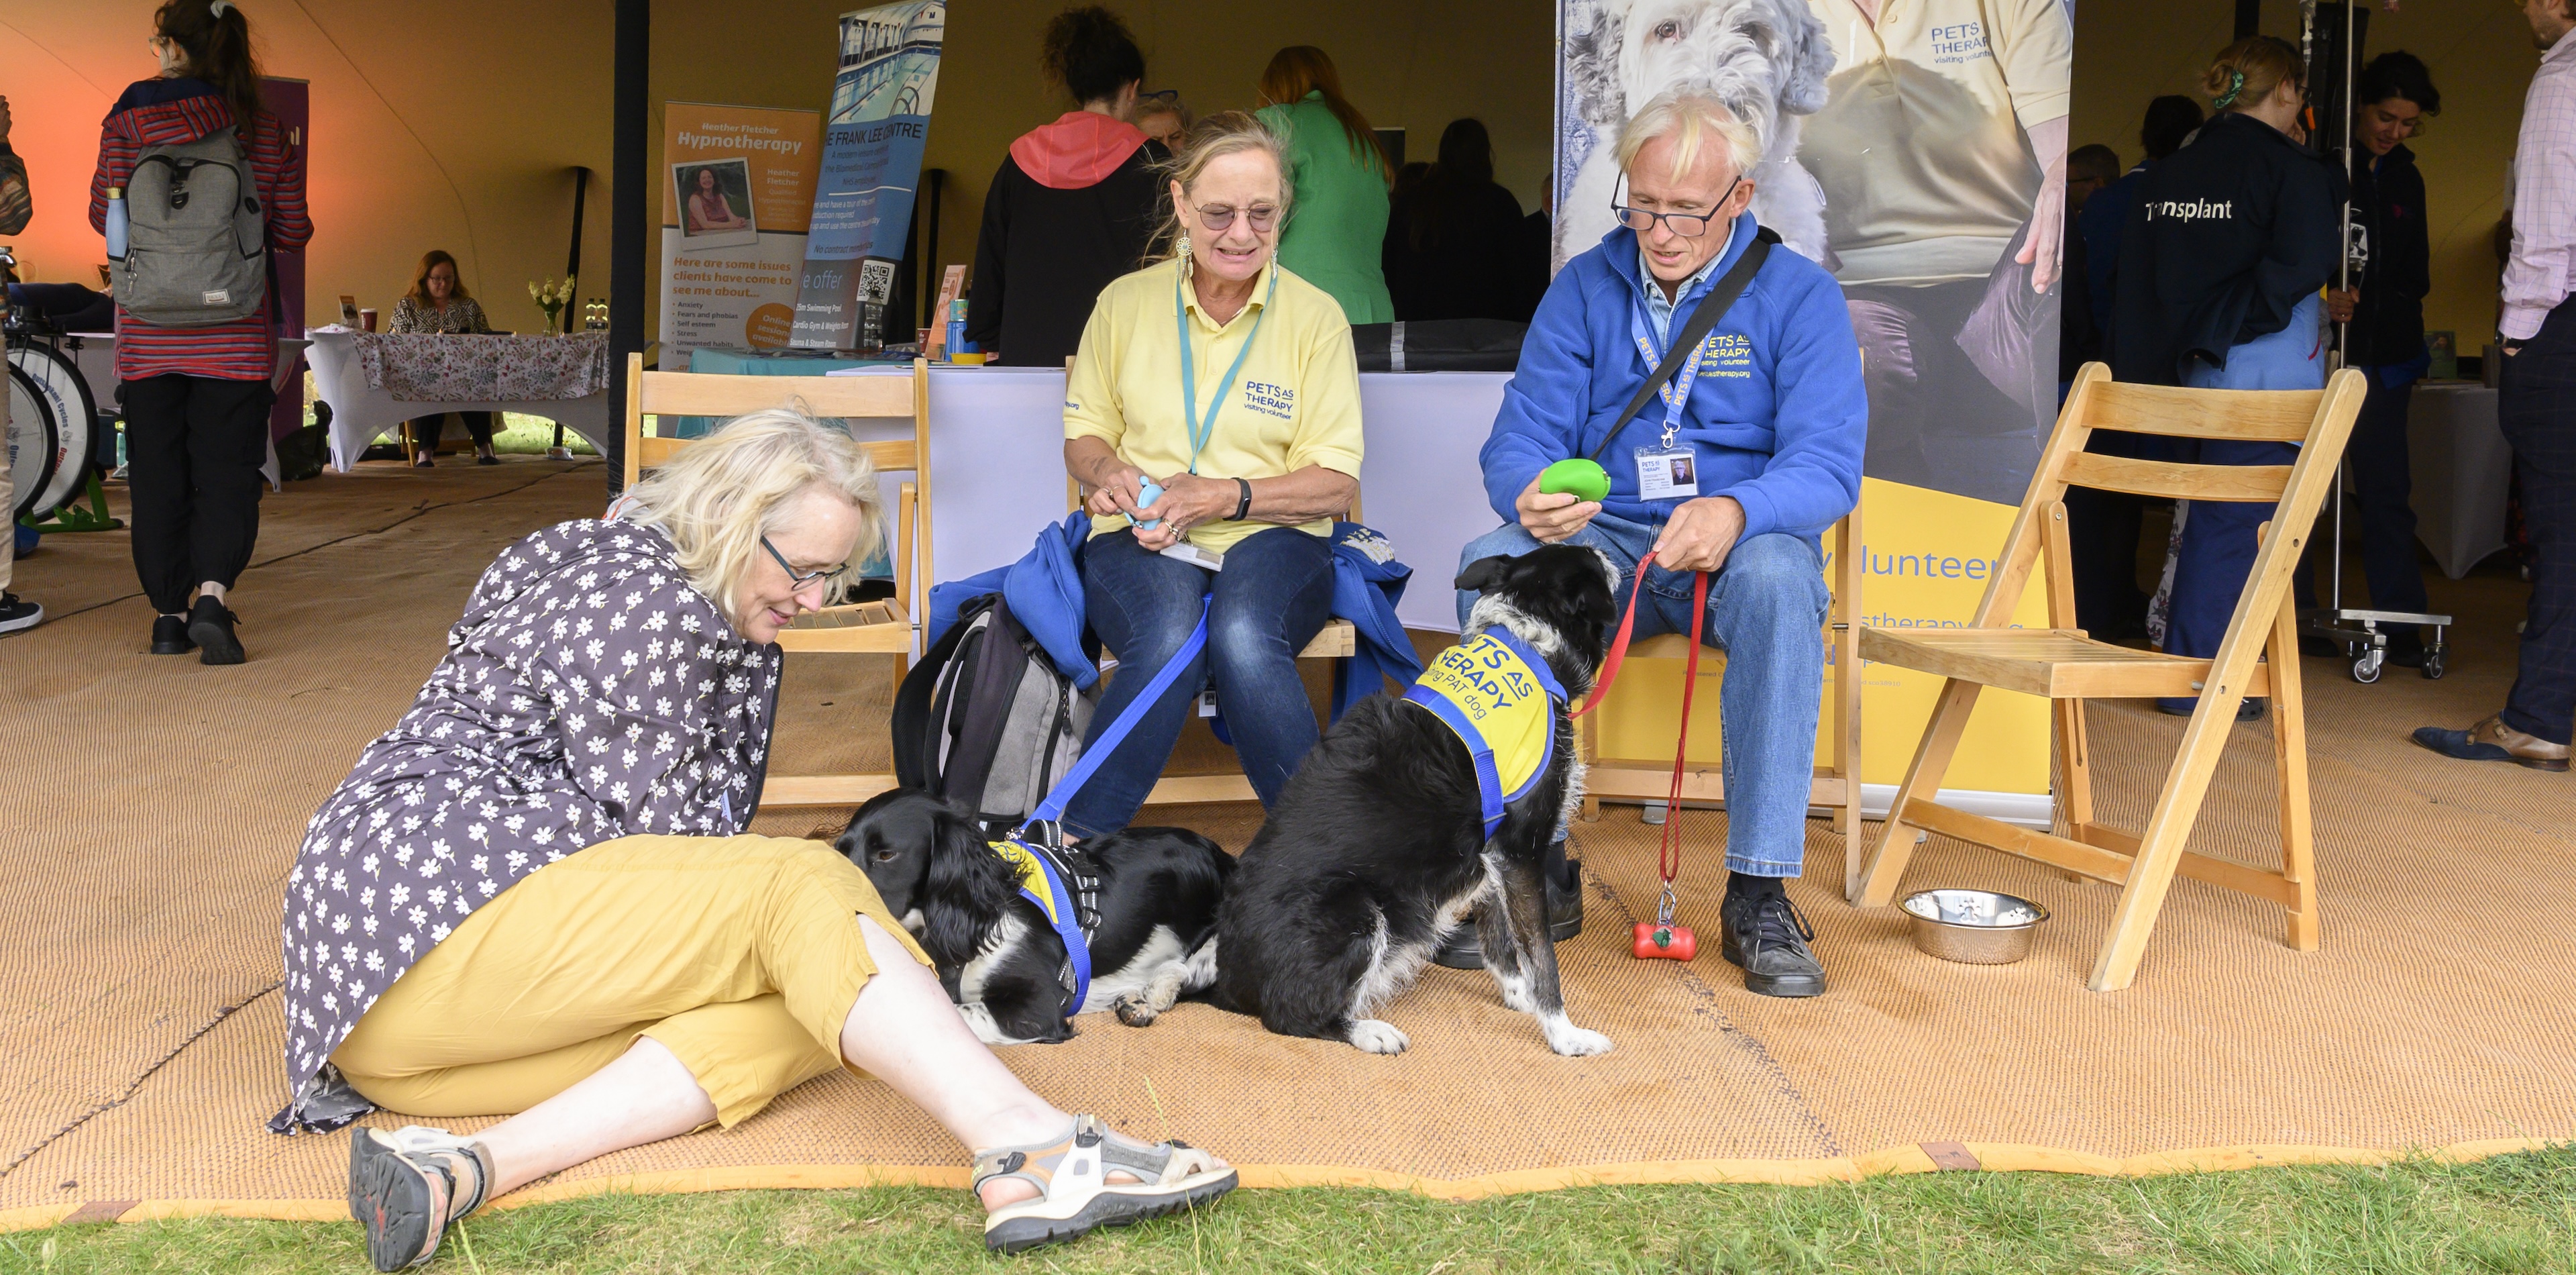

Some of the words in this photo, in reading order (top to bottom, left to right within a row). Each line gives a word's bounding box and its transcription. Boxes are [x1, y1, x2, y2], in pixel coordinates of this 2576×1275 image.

[1931, 22, 1979, 41] PETS
[1931, 36, 1988, 54] THERAP
[1934, 56, 1963, 64] visiting
[702, 123, 739, 132] Heather
[741, 125, 780, 134] Fletcher
[835, 130, 867, 146] FRANK
[867, 128, 883, 143] LEE
[882, 122, 922, 141] CENTRE
[678, 132, 802, 155] Hypnotherapy
[767, 168, 800, 176] Heather
[767, 177, 800, 186] Fletcher
[2145, 197, 2232, 223] Transplant
[814, 244, 824, 254] No
[824, 243, 849, 254] contract
[674, 257, 701, 267] Here
[704, 260, 723, 268] are
[725, 260, 756, 270] some
[758, 260, 792, 271] issues
[673, 271, 712, 282] clients
[714, 272, 742, 283] have
[745, 274, 777, 285] come
[780, 274, 792, 285] to
[813, 270, 843, 289] offer
[673, 286, 691, 295] see
[694, 287, 712, 296] me
[714, 287, 760, 298] about...
[678, 301, 704, 310] Anxiety
[806, 303, 832, 314] Swimming
[832, 304, 842, 313] Pool
[711, 312, 739, 320] phobias
[792, 321, 808, 329] Cardio
[809, 321, 821, 332] Gym
[676, 340, 711, 348] Unwanted
[713, 340, 734, 348] habits
[752, 333, 788, 346] availabl
[790, 338, 805, 347] Sauna
[809, 339, 825, 348] Steam
[1708, 335, 1734, 348] ETS
[676, 349, 693, 358] Weig
[1639, 337, 1656, 362] PETS
[1705, 348, 1751, 358] HERAPY
[1246, 381, 1281, 397] PETS
[1282, 389, 1294, 399] AS
[1674, 382, 1688, 406] PETS
[1245, 392, 1293, 412] THERAPY
[57, 402, 68, 427] Cycles
[1244, 403, 1266, 414] visiting
[1267, 408, 1292, 420] volunteer
[1506, 672, 1534, 697] AS
[1442, 674, 1469, 693] PAT
[1464, 695, 1487, 720] dog
